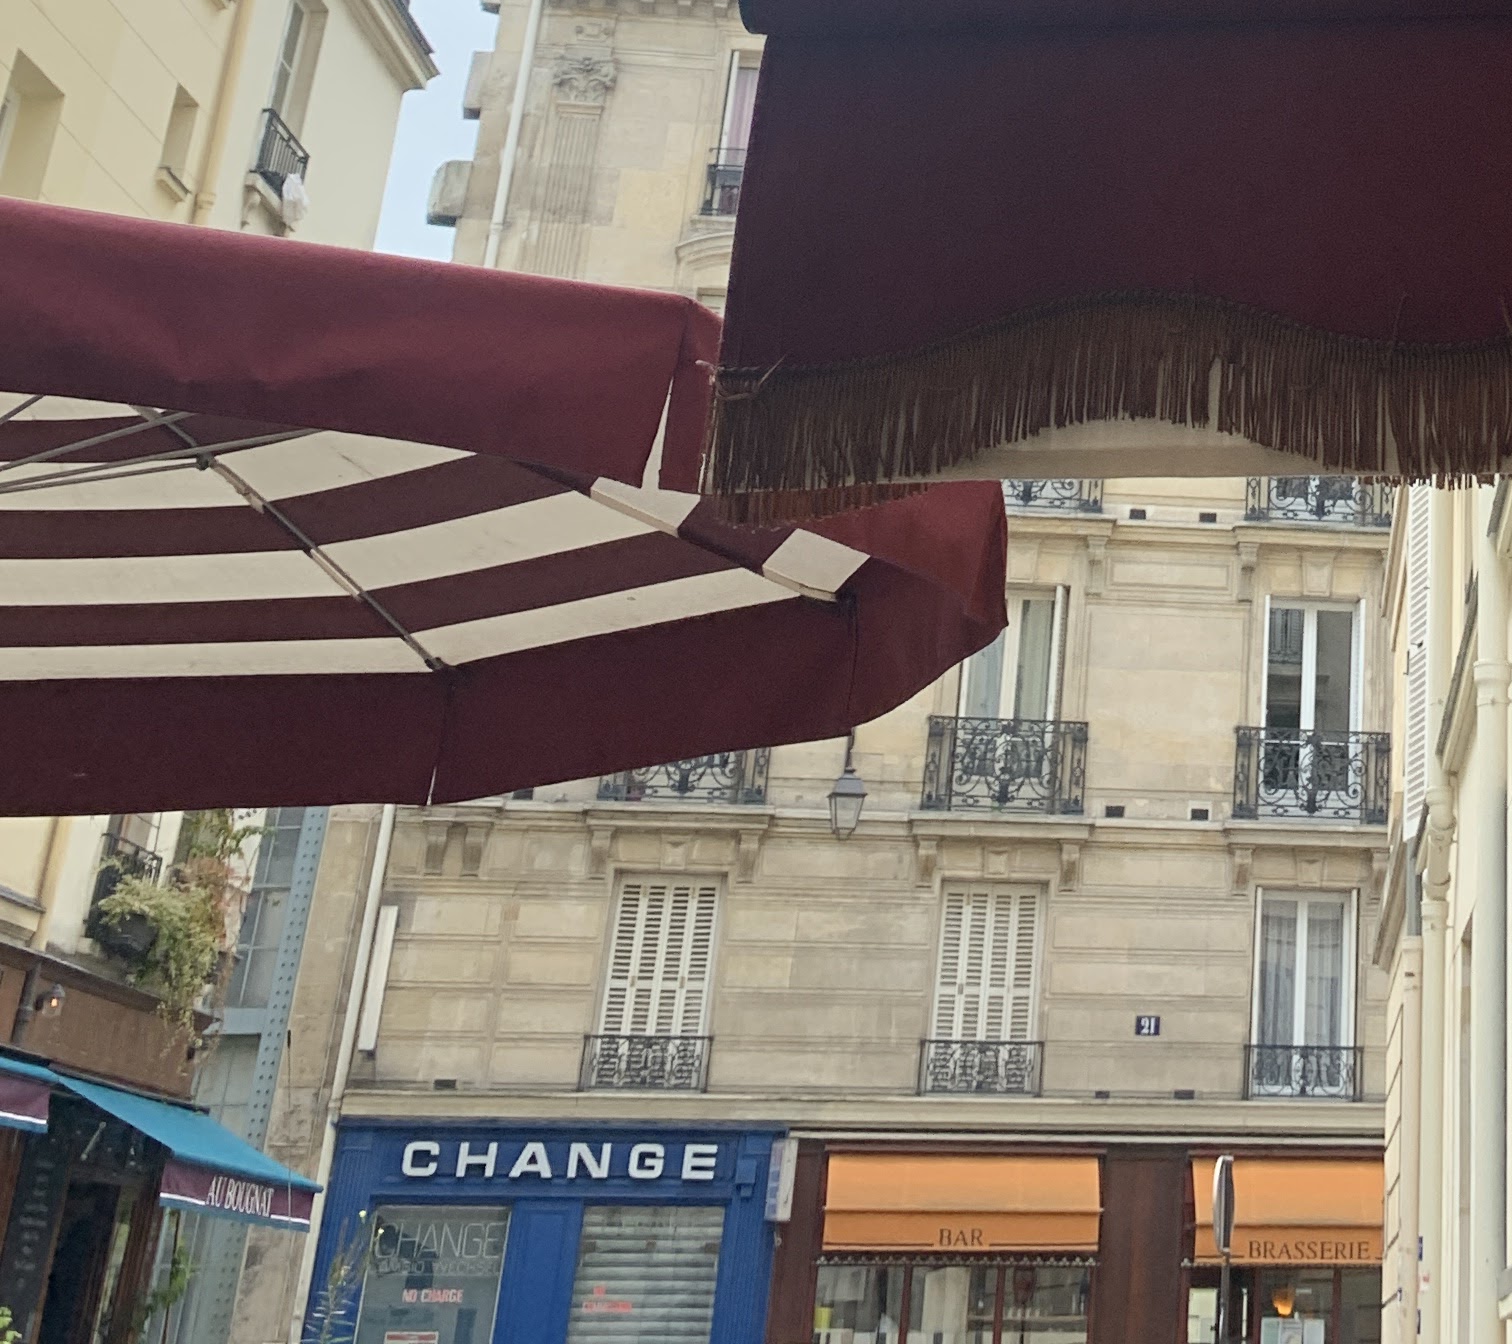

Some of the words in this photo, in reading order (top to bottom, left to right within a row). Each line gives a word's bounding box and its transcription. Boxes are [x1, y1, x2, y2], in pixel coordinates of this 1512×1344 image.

[1140, 1016, 1156, 1034] 21
[401, 1141, 719, 1180] CHANGE
[205, 1174, 228, 1208] AU
[224, 1178, 275, 1218] BOUGNAT
[375, 1221, 506, 1259] CHANGE
[939, 1228, 984, 1247] BAR
[1248, 1240, 1371, 1260] BRASSERIE
[402, 1289, 418, 1303] NO
[420, 1288, 464, 1303] CHARGE
